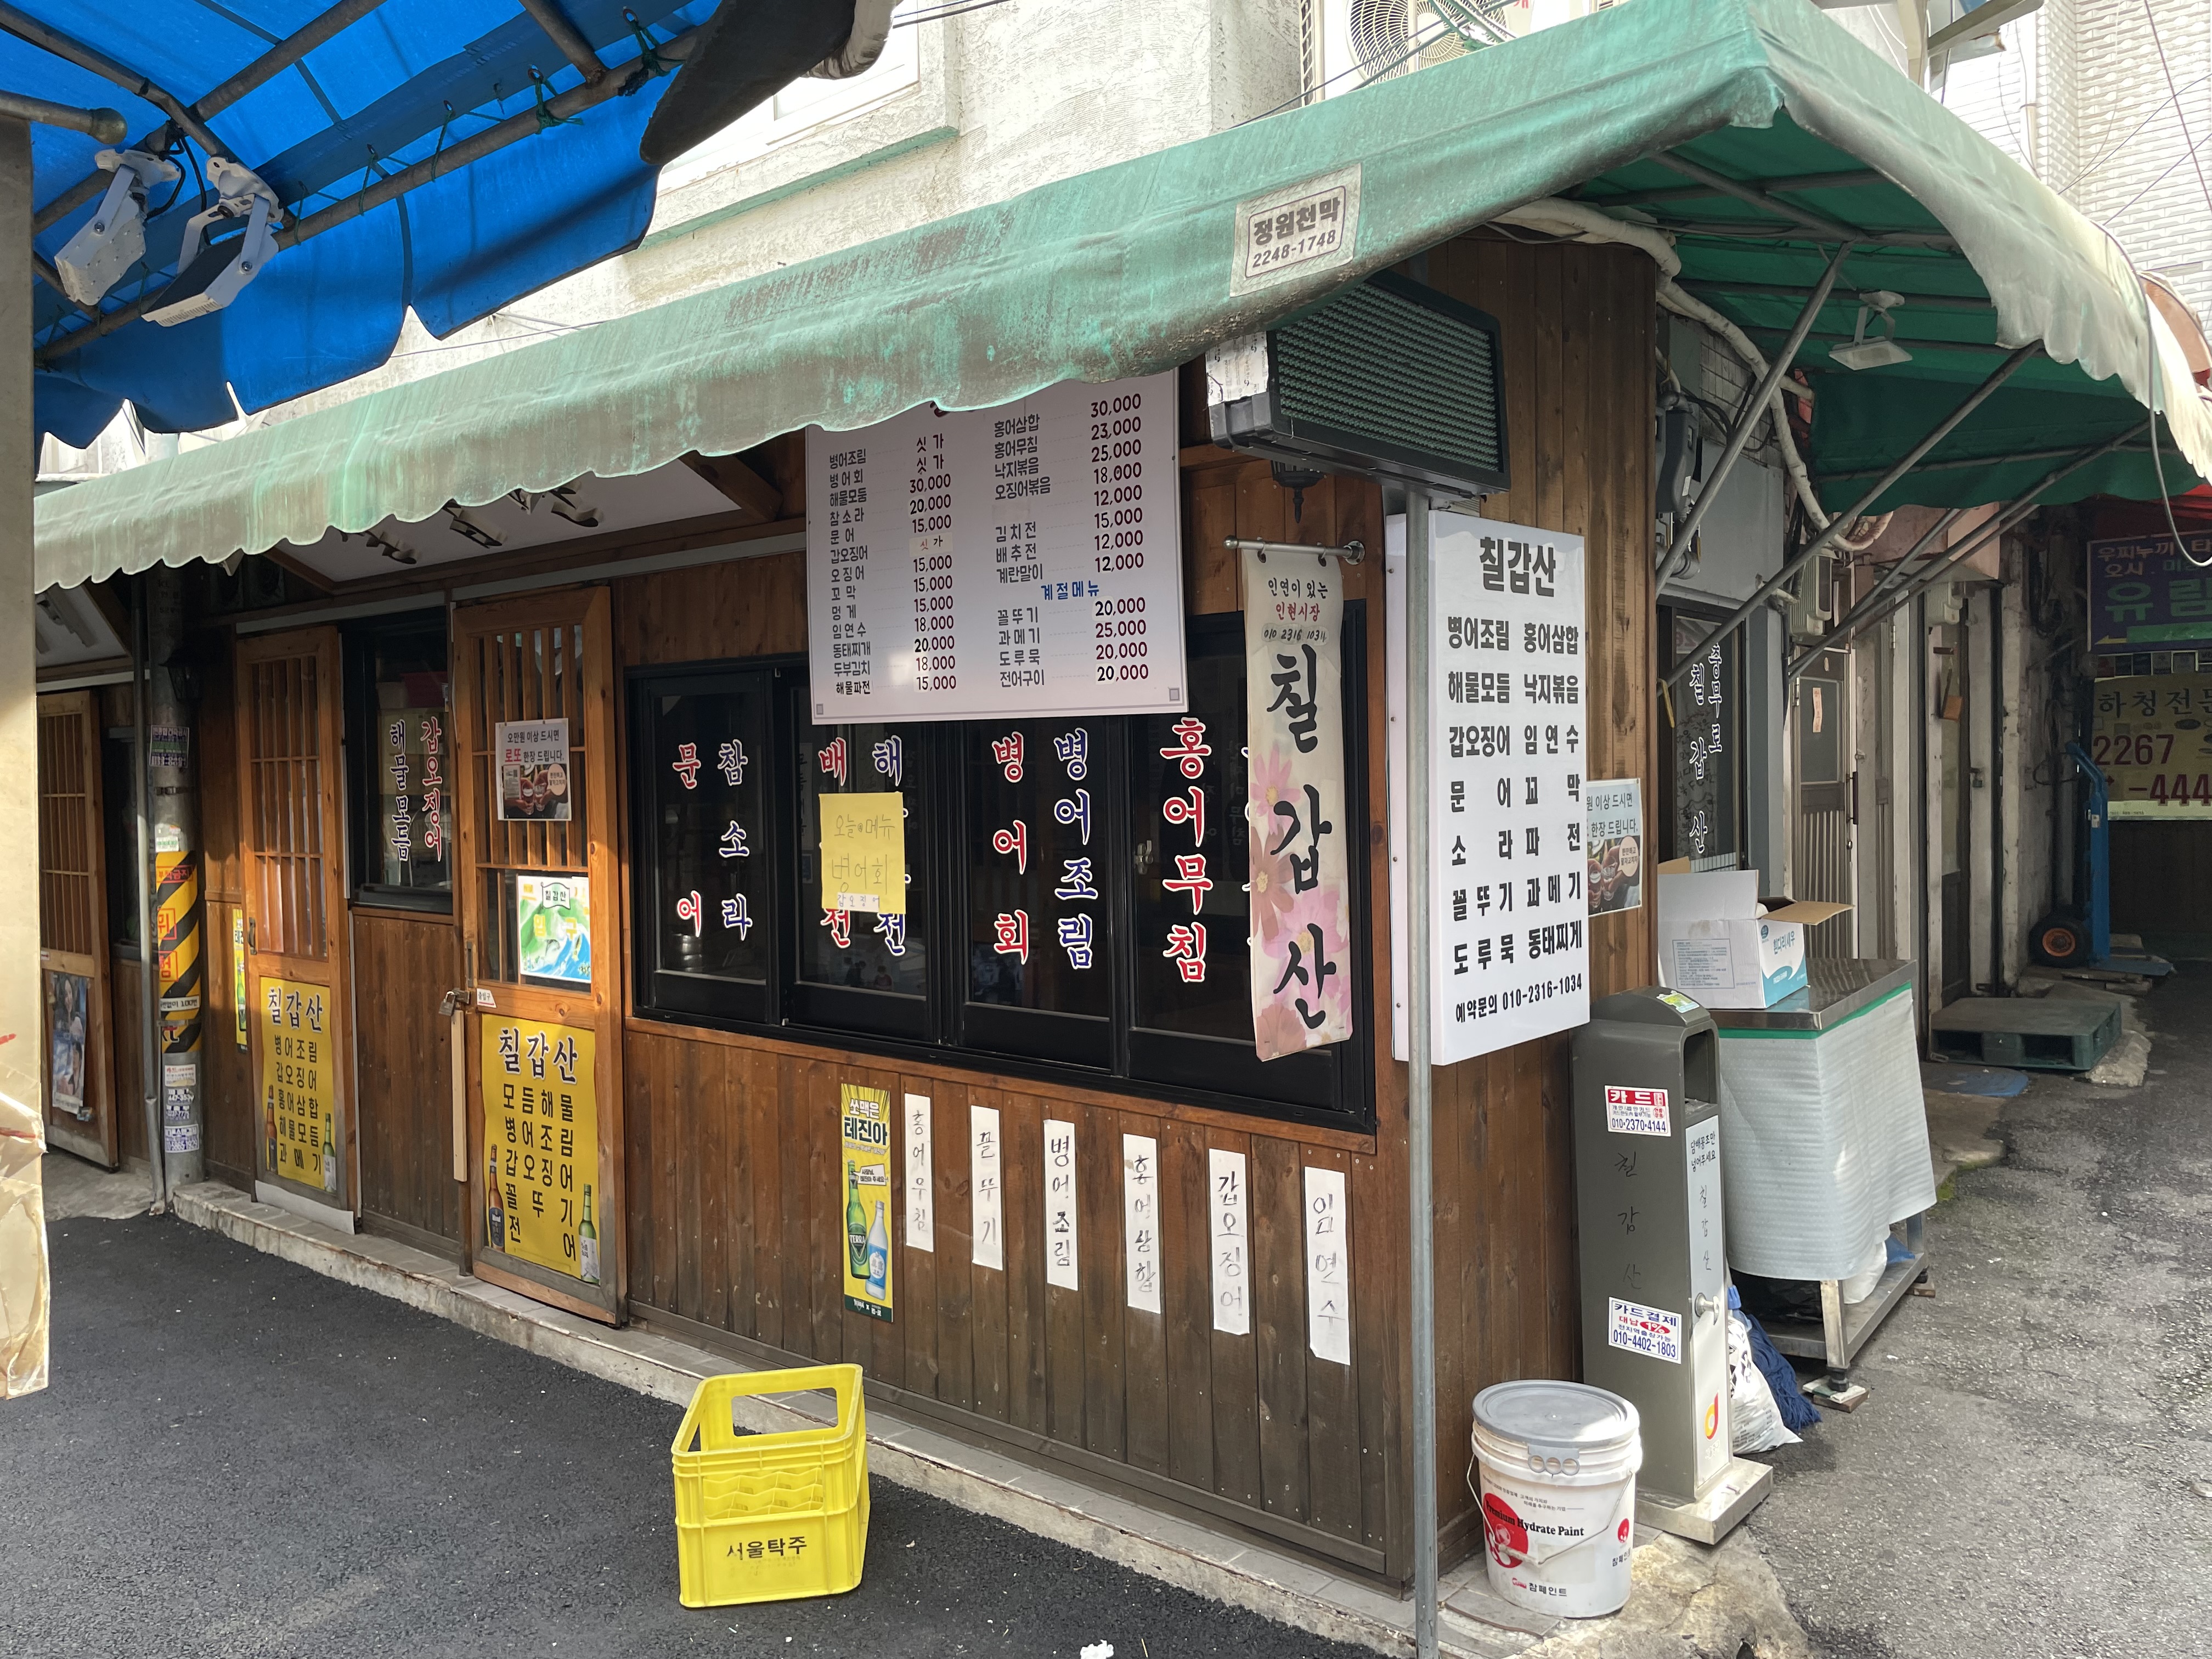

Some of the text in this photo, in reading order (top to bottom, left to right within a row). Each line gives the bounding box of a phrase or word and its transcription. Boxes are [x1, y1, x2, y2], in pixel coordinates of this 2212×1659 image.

[1254, 196, 1340, 246] 정원천막
[1252, 229, 1336, 268] 2248-1748
[994, 393, 1142, 437] 홍어삼합 30,000
[829, 433, 945, 469] 병어조림 싯가
[994, 416, 1142, 459] 홍어무침 23,000
[830, 454, 945, 488] 병어회 싯가
[994, 439, 1142, 479] 낙지볶음 25,000
[909, 473, 951, 494] 30,000
[995, 462, 1143, 500] 오징어볶음 18,000
[1093, 484, 1143, 506] 12,000
[830, 494, 952, 527] 참소라 20,000
[996, 507, 1143, 542] 김치전 15,000
[830, 515, 952, 545] 문어 15,000
[830, 536, 944, 565] 갑오징어 싯가
[996, 530, 1144, 563] 배추전 12,000
[831, 555, 953, 583] 오징어 15,000
[997, 553, 1144, 584] 계란말이 12,000
[1480, 537, 1556, 597] 칠갑산
[831, 575, 953, 601] 꼬막 15,000
[1041, 581, 1100, 600] 계절메뉴
[1268, 577, 1328, 599] 인연이 있는
[832, 596, 954, 620] 멍게 15,000
[997, 597, 1146, 626] 꼴뚜기 20,000
[1276, 602, 1320, 622] 인현시장
[832, 616, 955, 640] 임연수 18,000
[998, 619, 1147, 646] 과메기 25,000
[1263, 629, 1277, 639] 010
[1281, 629, 1302, 641] 2316
[1448, 616, 1579, 654] 병어조림 홍어삼합
[913, 636, 955, 653] 20,000
[1000, 642, 1148, 666] 도루묵 20,000
[834, 656, 956, 678] 두부김치 18,000
[1000, 664, 1149, 688] 전어구이 20,000
[836, 675, 957, 696] 해물파전 15,000
[1448, 671, 1579, 704] 해물모듬 낙지볶음
[507, 730, 559, 743] 오만원 이상 드시면
[1449, 724, 1579, 758] 갑오징어 임연수
[2093, 734, 2174, 766] 2267
[505, 748, 564, 763] 로또 한장 드립니다.
[1689, 663, 1708, 854] 칠갑산
[390, 719, 411, 861] 해물모듬
[420, 716, 442, 862] 갑오징어
[1451, 774, 1581, 812] 문어 꼬막
[1595, 792, 1633, 811] 이상 드시면
[718, 739, 753, 940] 참소라
[1267, 644, 1336, 1030] 칠갑산
[1592, 818, 1638, 838] 한장 드립니다.
[992, 731, 1029, 964] 병어회
[1054, 727, 1098, 969] 병어조림
[1160, 717, 1213, 983] 홍어무침
[1452, 823, 1581, 866] 소라 파전
[545, 890, 566, 901] 칠갑산
[838, 895, 880, 908] 갑오징어
[1453, 871, 1581, 922] 꼴뚜기 과메기
[1454, 933, 1514, 975] 도루묵
[267, 987, 323, 1033] 칠갑산
[1456, 973, 1582, 1023] 예약문의 010-2316-1034
[274, 1035, 318, 1063] 병어조림
[498, 1027, 578, 1085] 칠갑산
[275, 1061, 318, 1093] 갑오징어
[278, 1088, 319, 1119] 홍어삼합
[850, 1098, 879, 1119] 쏘맥은
[1610, 1090, 1651, 1104] 카드
[505, 1115, 574, 1158] 병어조림
[844, 1116, 888, 1146] 테진아
[279, 1142, 322, 1175] 과메기
[505, 1148, 574, 1192] 갑오징어
[505, 1182, 574, 1227] 꼴뚜기
[849, 1234, 866, 1244] TERRA
[1216, 1170, 1245, 1316] 갑오징어
[1700, 1185, 1712, 1271] 칠갑산
[1615, 1304, 1676, 1327] 카드결제
[1646, 1322, 1664, 1333] 1%
[1614, 1329, 1675, 1357] 010-4402-1803
[1486, 1500, 1584, 1536] Premium Hydrate Paint
[726, 1536, 807, 1560] 서울탁주
[1529, 1583, 1567, 1596] 참페인트
